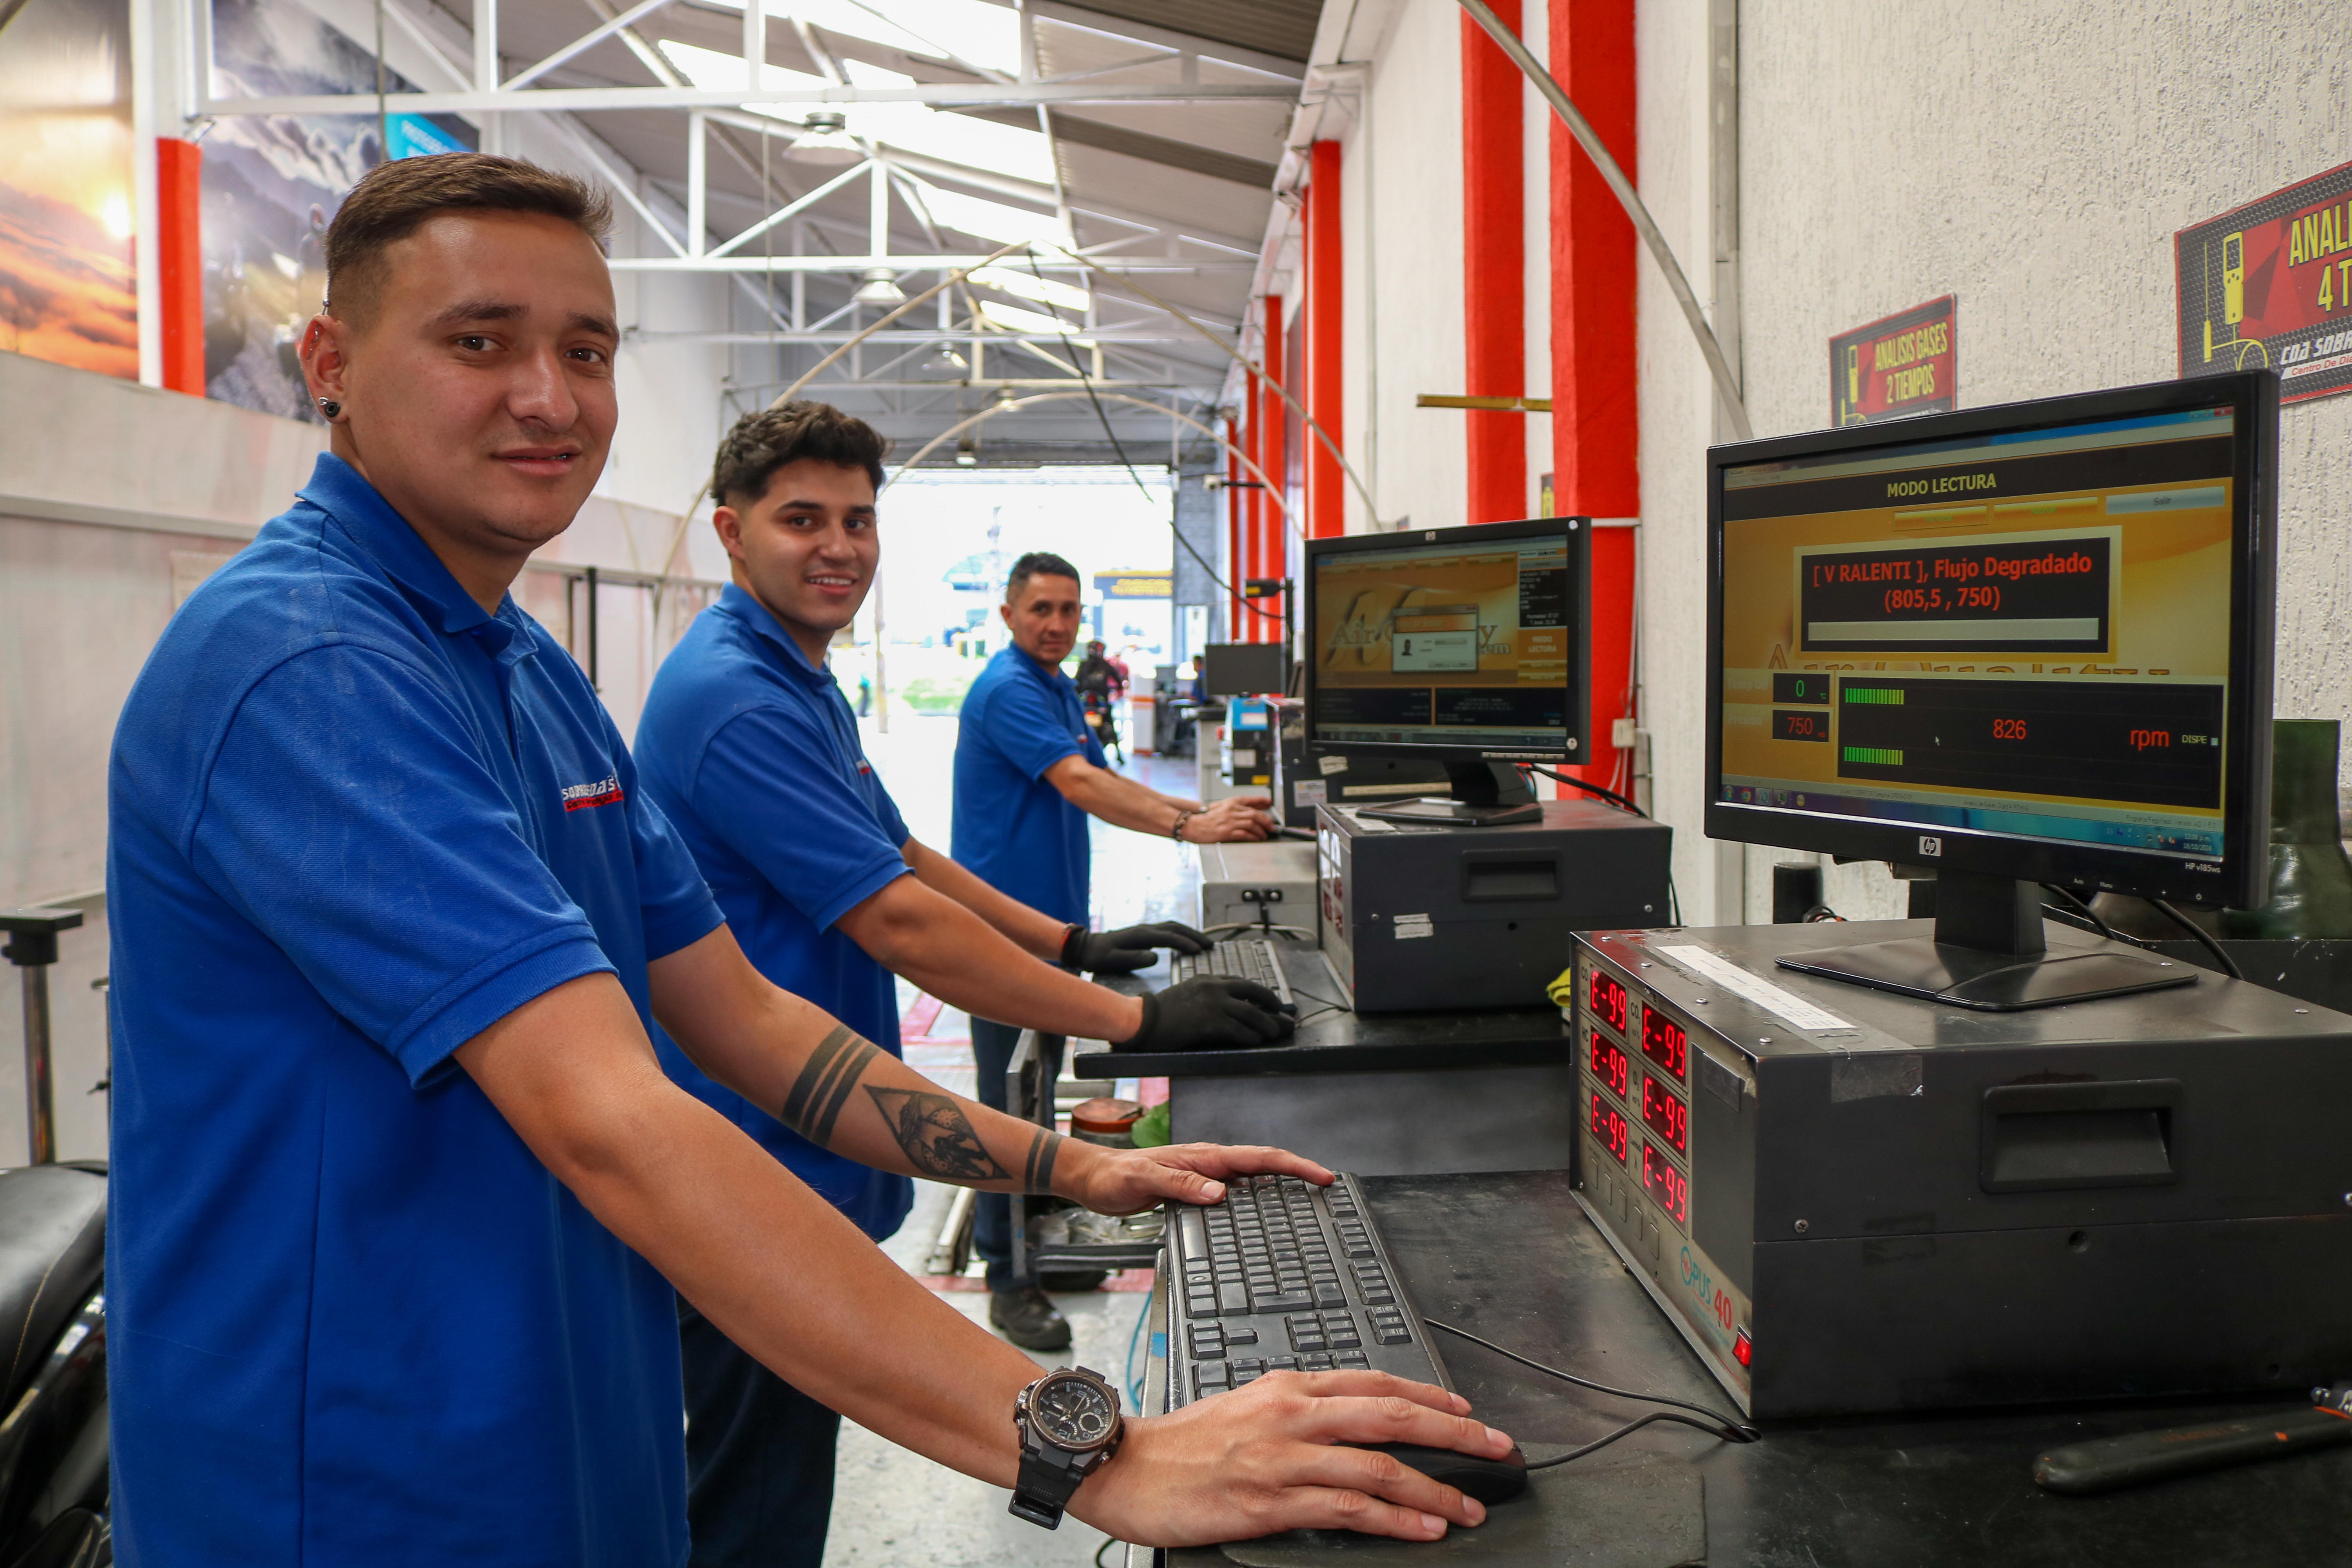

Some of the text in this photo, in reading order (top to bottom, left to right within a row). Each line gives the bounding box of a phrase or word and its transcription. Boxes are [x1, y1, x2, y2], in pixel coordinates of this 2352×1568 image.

[2288, 200, 2352, 267] ANALI
[2318, 265, 2334, 312] 4
[1875, 321, 1948, 372] ANALISIS GASES
[2292, 363, 2321, 375] Centro
[2324, 359, 2337, 368] De
[1886, 363, 1935, 404] 2 TIEMPOS
[1887, 473, 1996, 497] MODO LECTURA
[2153, 496, 2171, 506] Salir
[1824, 565, 1835, 583] V
[1839, 561, 1911, 582] RALENTI
[1935, 557, 1979, 585] Flujo
[1984, 552, 2092, 581] Degradado
[1884, 588, 1941, 612] (805,5
[1958, 586, 2001, 610] 750)
[1331, 623, 1376, 645] Air
[1528, 644, 1557, 653] LECTURA
[1795, 680, 1805, 697] 0
[1787, 717, 1813, 735] 750
[1993, 719, 2027, 740] 826
[2130, 729, 2170, 751] rpm
[2182, 734, 2207, 745] DISPE
[2185, 862, 2221, 873] HP v185ws
[1590, 970, 1627, 1031] E-99
[1642, 1008, 1686, 1077] E-99
[1591, 1033, 1627, 1096] E-99
[1592, 1094, 1627, 1161] E-99
[1643, 1077, 1686, 1151] E-99
[1643, 1145, 1686, 1223] E-99
[1680, 1245, 1712, 1306] OPUS
[1714, 1288, 1733, 1331] 40
